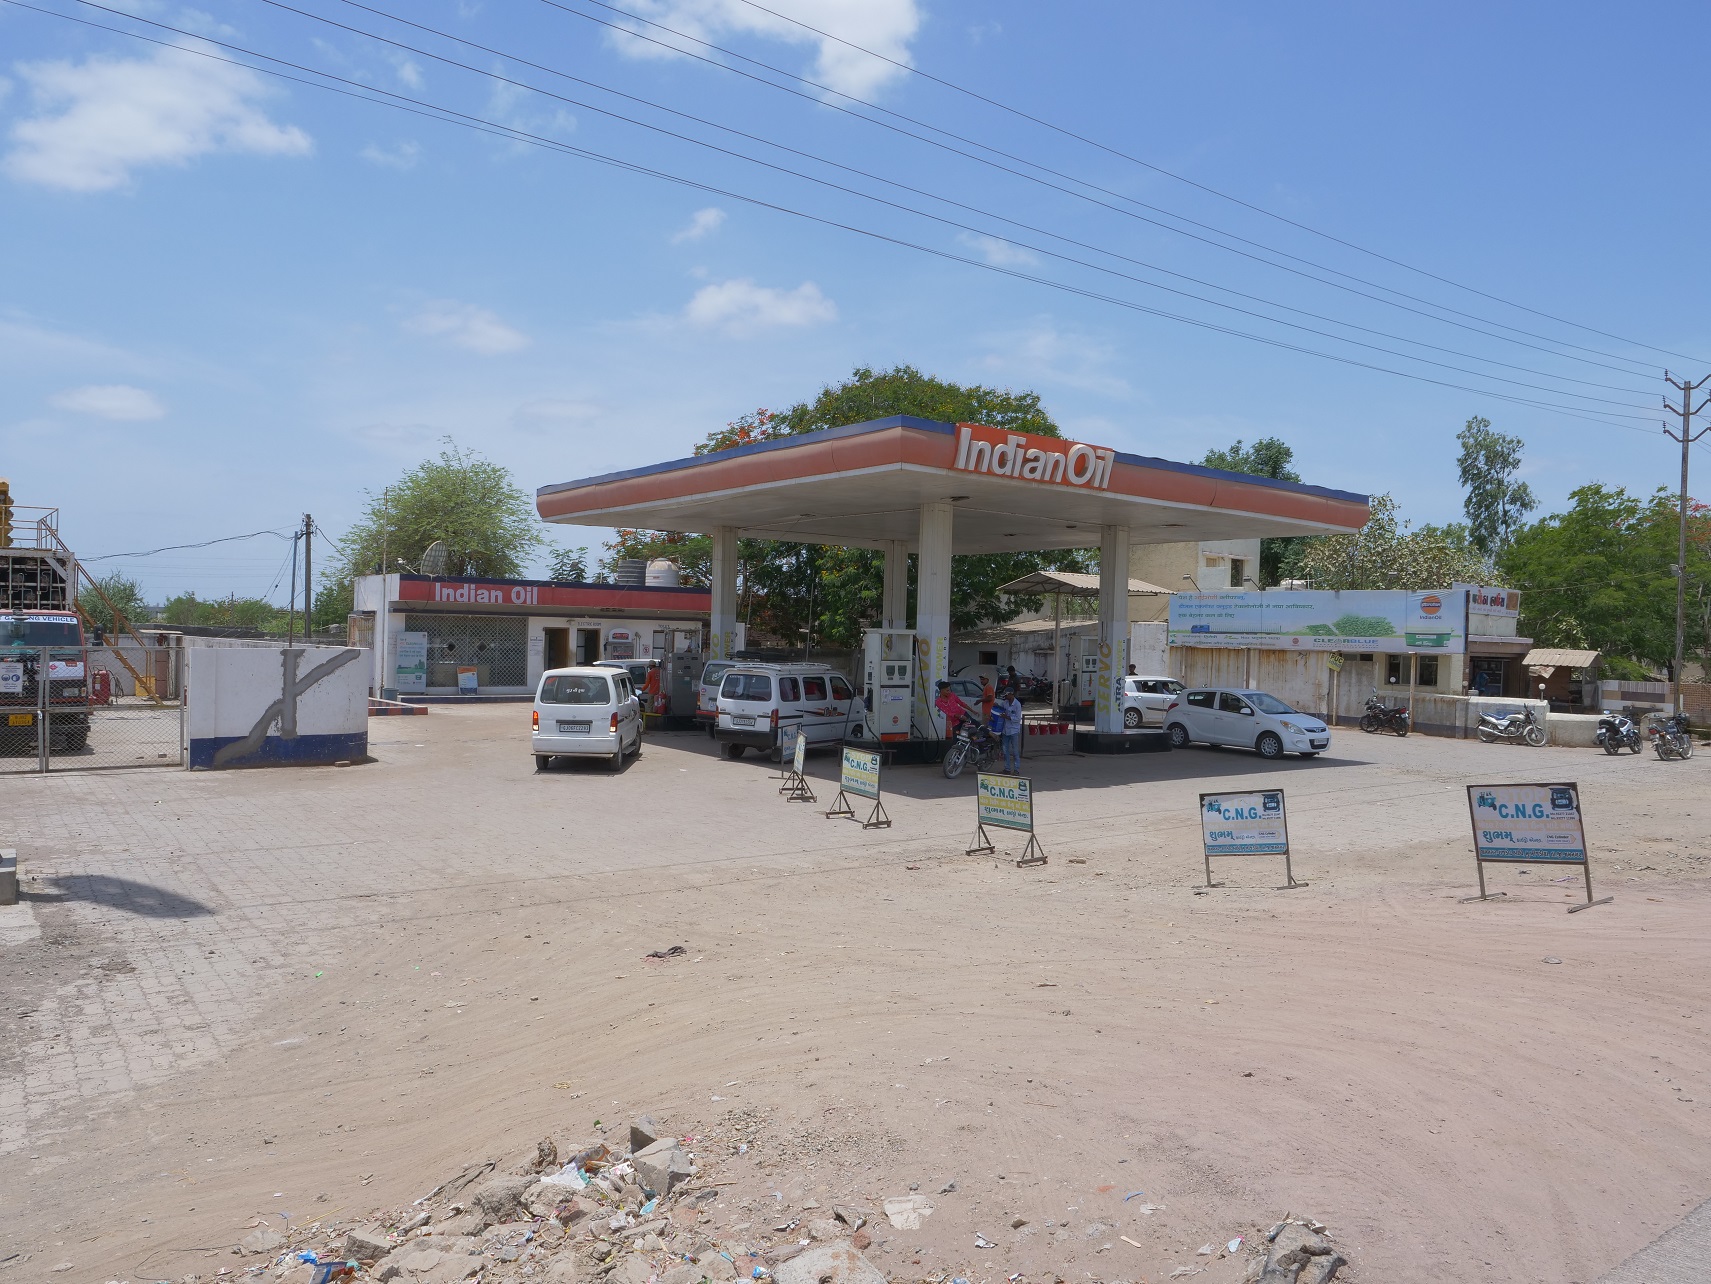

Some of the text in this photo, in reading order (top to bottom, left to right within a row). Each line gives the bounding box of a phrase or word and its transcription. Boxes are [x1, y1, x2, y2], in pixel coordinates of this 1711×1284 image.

[953, 427, 1115, 488] IndianOil
[435, 582, 538, 605] Indian Oil
[917, 638, 931, 717] SERVO
[1097, 641, 1112, 716] SERVO
[850, 759, 870, 772] C.N.G.
[989, 776, 1016, 787] STOP
[990, 786, 1017, 800] C.N.G.
[1222, 806, 1262, 821] C.N.G.
[1498, 803, 1550, 819] C.N.G.
